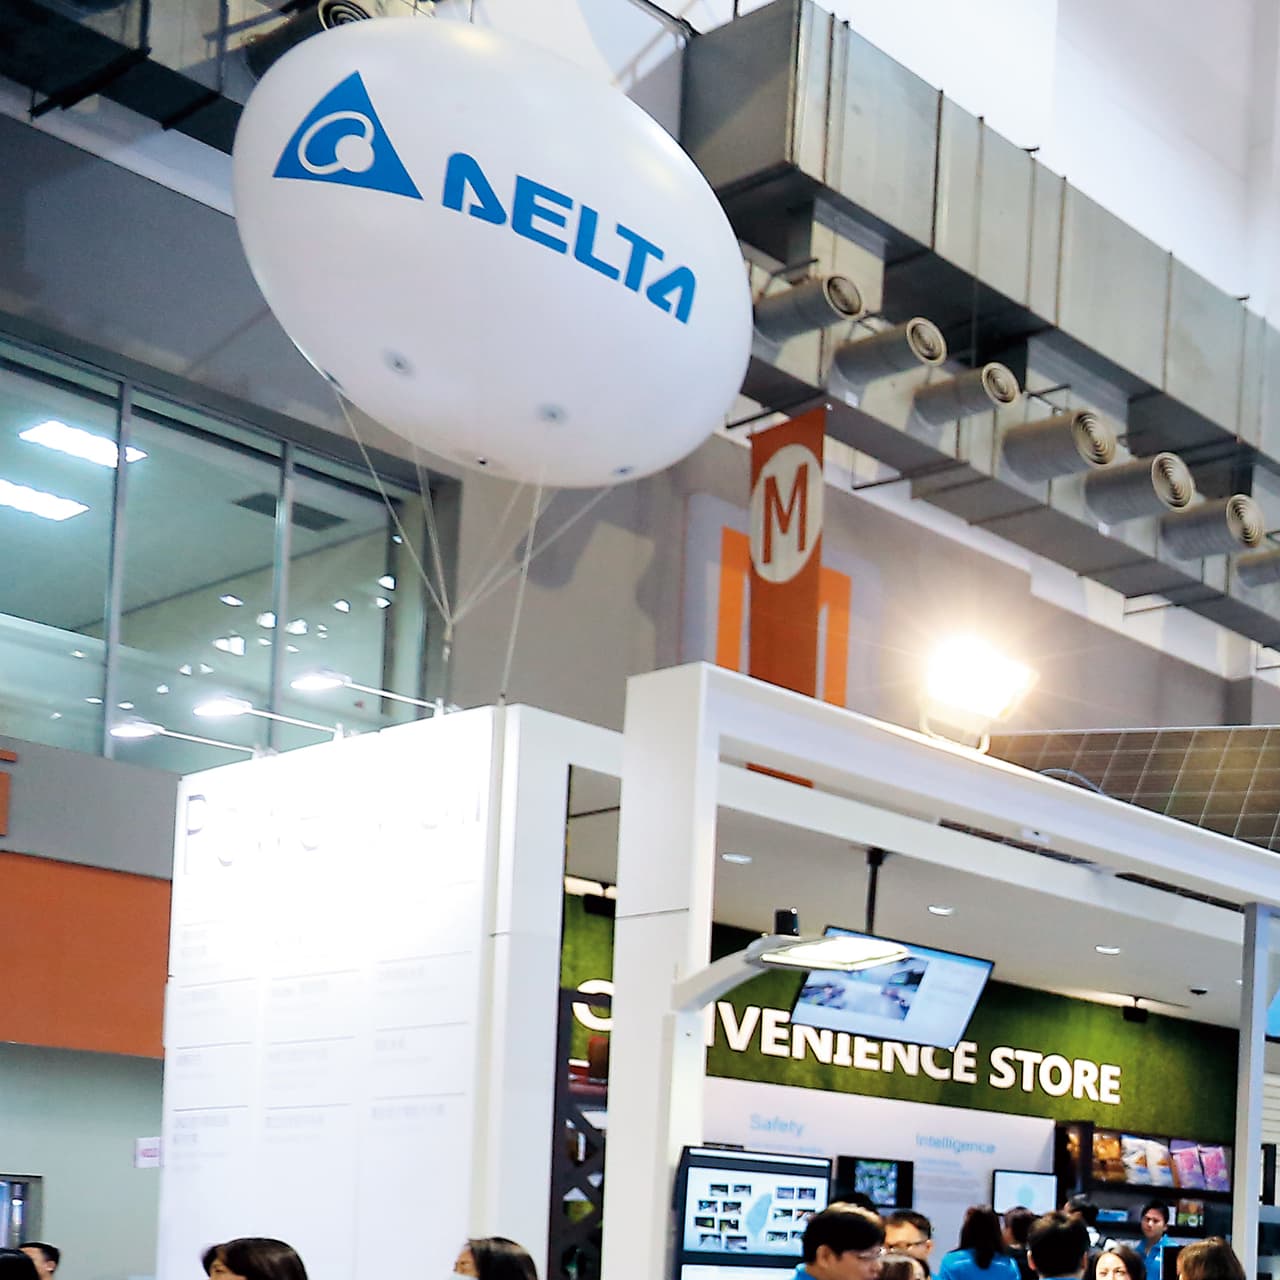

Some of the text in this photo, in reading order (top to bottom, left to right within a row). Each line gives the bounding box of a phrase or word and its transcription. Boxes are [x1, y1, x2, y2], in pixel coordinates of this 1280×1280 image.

[442, 152, 696, 324] DELTA
[762, 463, 809, 564] M
[988, 1044, 1122, 1106] STORE
[749, 1113, 806, 1138] Safety
[915, 1132, 997, 1155] Intelligence
